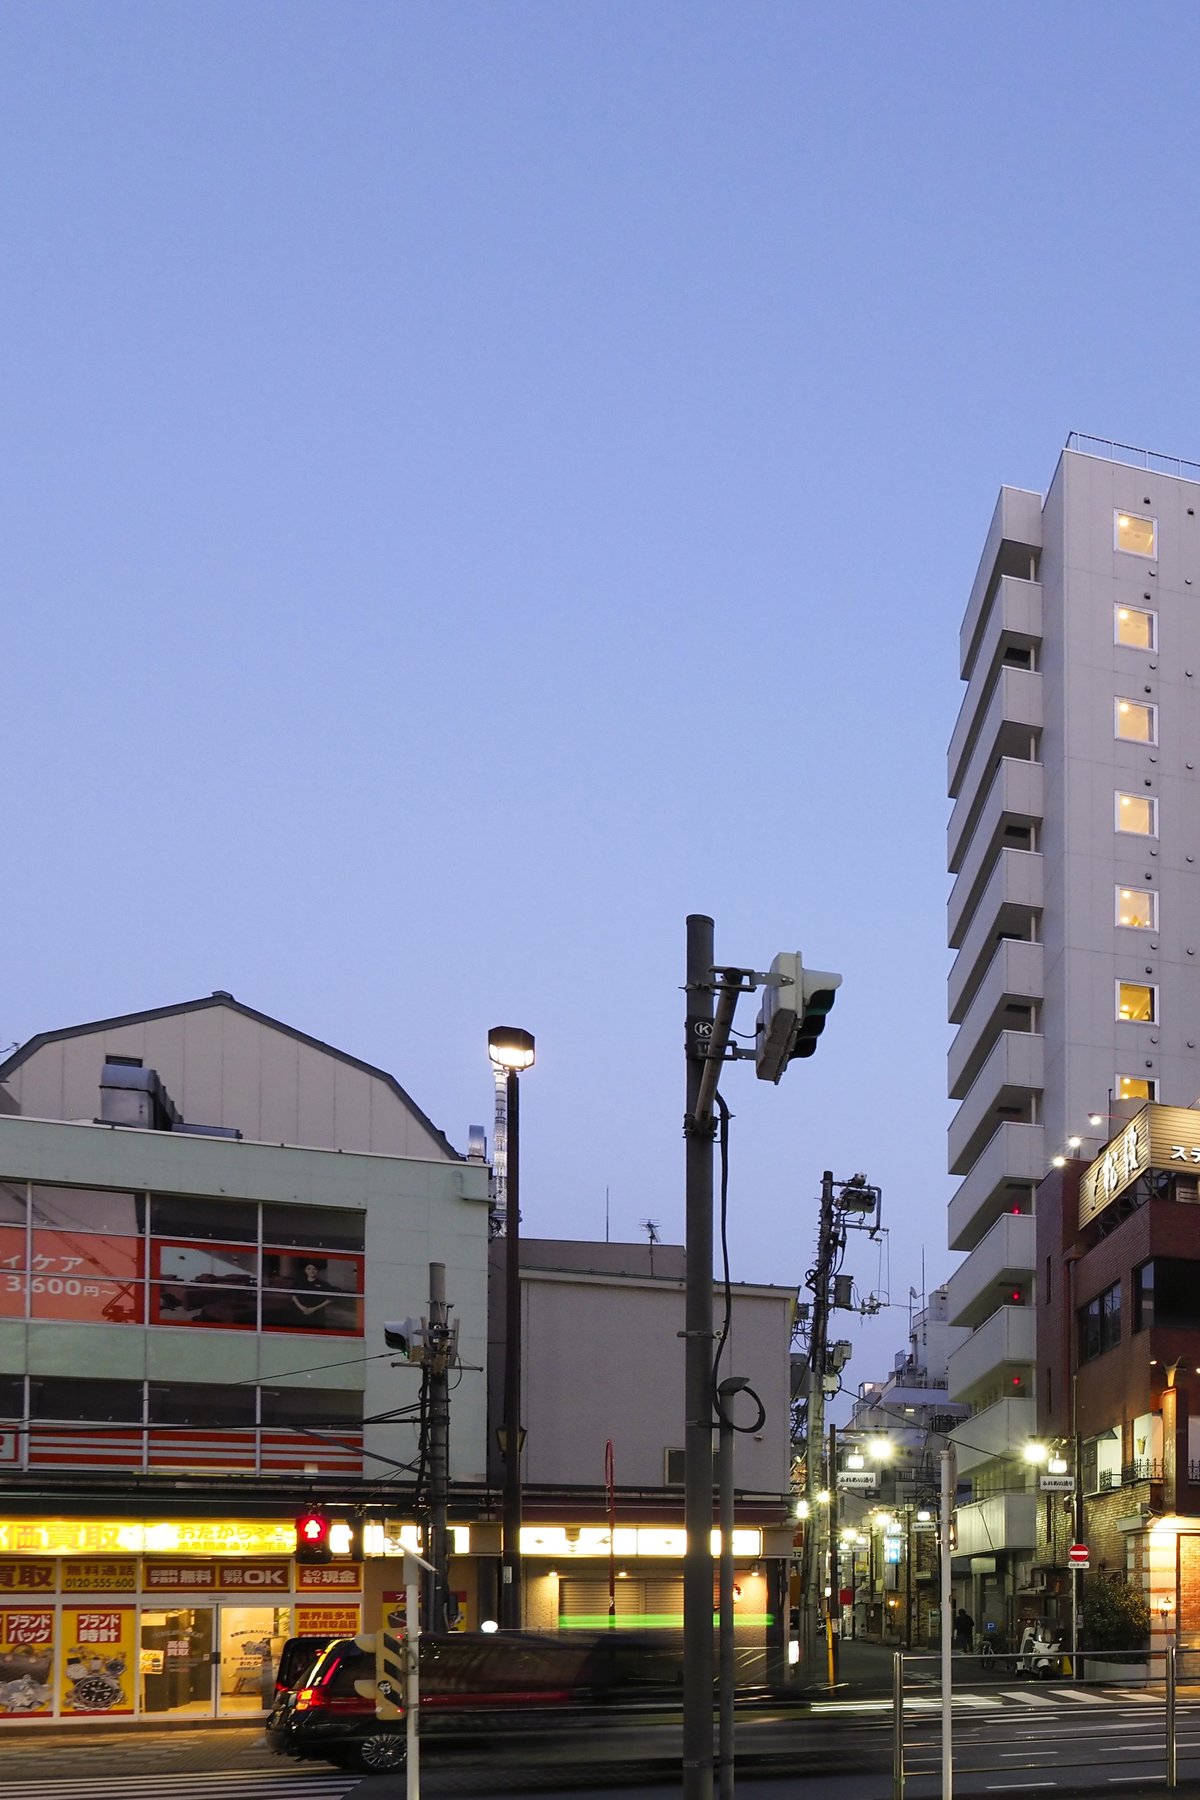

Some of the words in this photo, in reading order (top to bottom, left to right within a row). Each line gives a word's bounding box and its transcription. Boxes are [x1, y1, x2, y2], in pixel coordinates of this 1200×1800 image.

[66, 1565, 135, 1576] 無料通話
[180, 1569, 212, 1584] 無料
[243, 1569, 285, 1584] OK
[322, 1570, 356, 1584] 現金
[65, 1578, 135, 1588] 0120-555-600
[8, 1614, 51, 1629] ブランド
[79, 1614, 120, 1629] ブランド
[987, 1622, 995, 1630] P
[8, 1629, 51, 1642] バッグ
[79, 1629, 119, 1642] 時計
